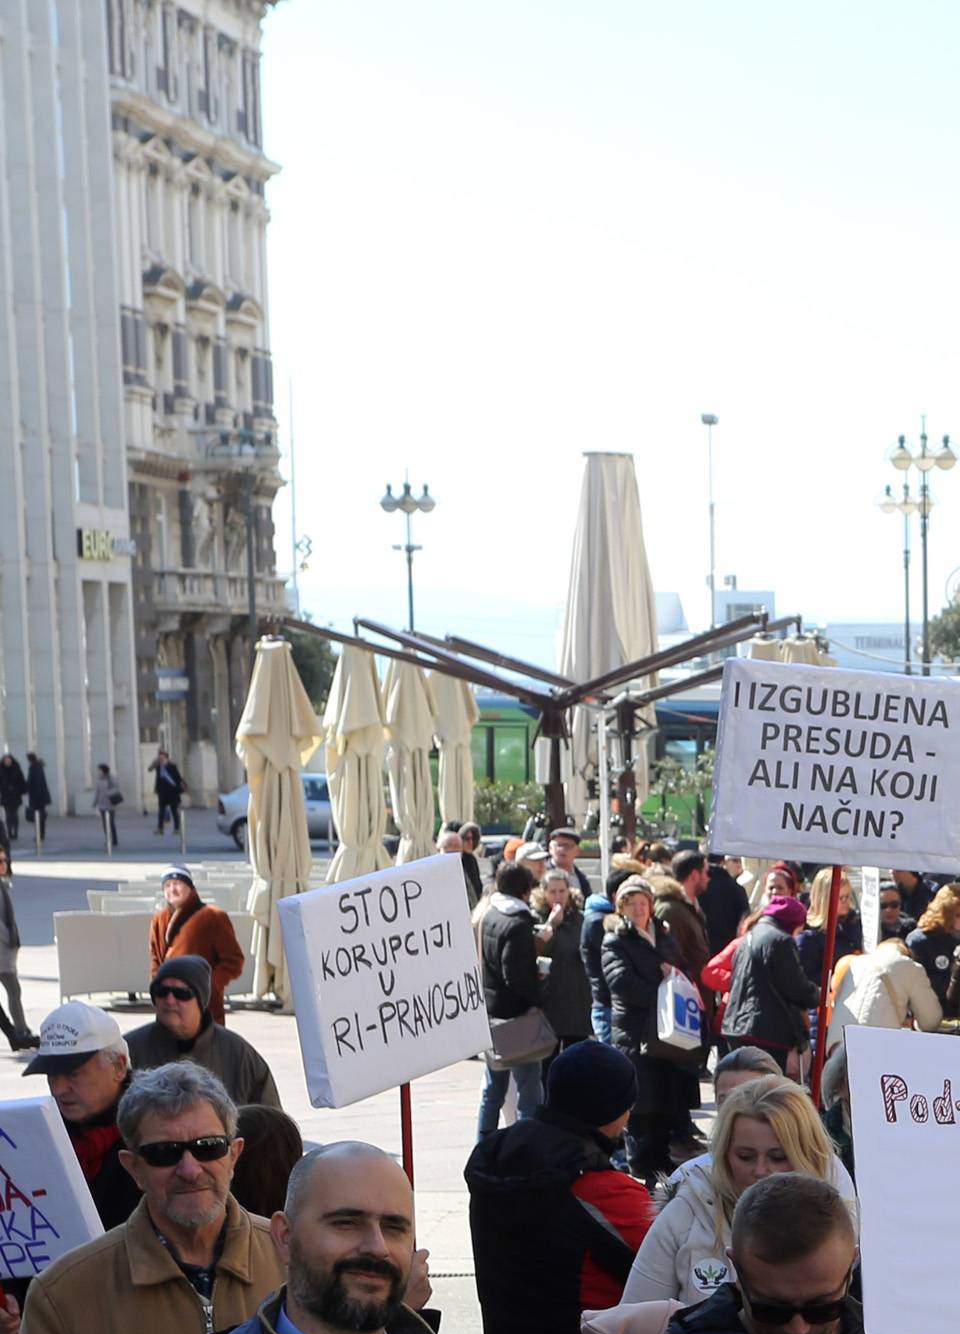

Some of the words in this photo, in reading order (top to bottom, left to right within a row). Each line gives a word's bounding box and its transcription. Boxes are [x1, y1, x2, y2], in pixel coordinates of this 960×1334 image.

[749, 681, 949, 728] IZGUBLJENA
[760, 722, 914, 763] PRESUDA
[748, 759, 799, 790] ALI
[810, 763, 858, 795] NA
[870, 768, 938, 802] KOJI
[781, 799, 904, 840] NAČIN?
[338, 880, 422, 934] STOP
[321, 921, 452, 981] KORUPCIJI
[378, 969, 395, 996] U
